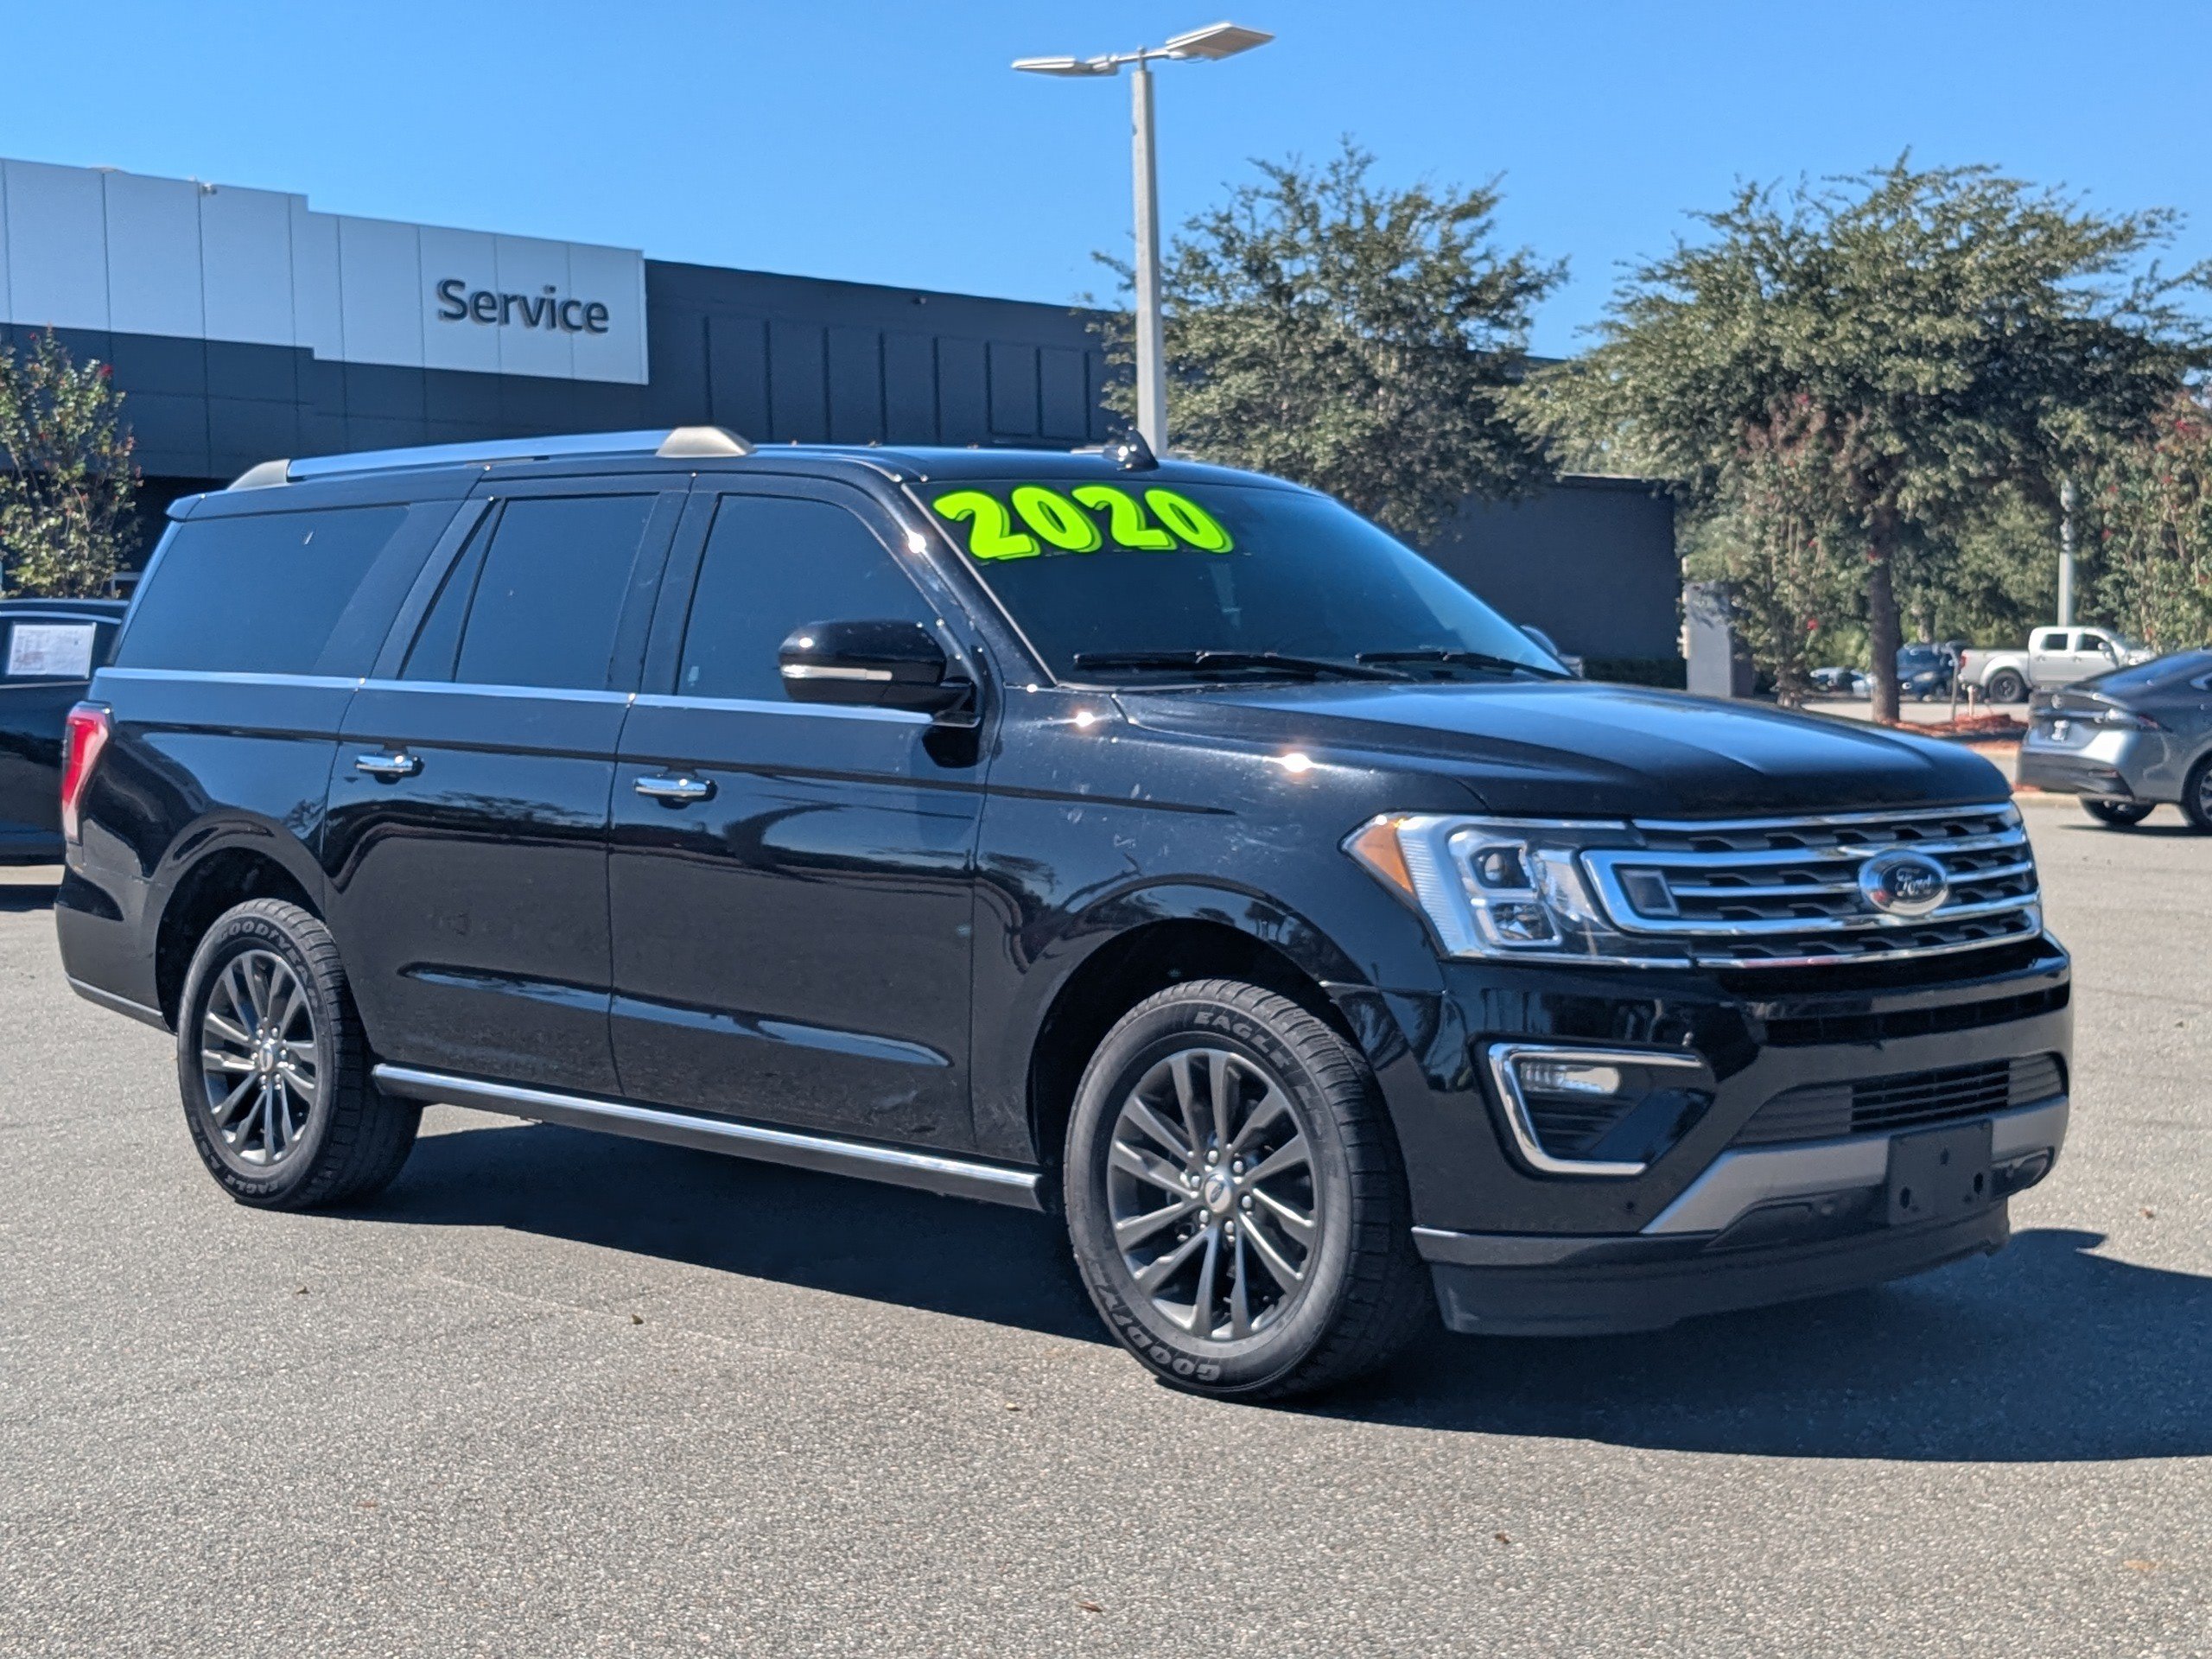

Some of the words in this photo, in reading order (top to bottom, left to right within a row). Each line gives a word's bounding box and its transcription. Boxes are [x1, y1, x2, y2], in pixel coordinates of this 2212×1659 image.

[436, 277, 610, 334] Service
[932, 486, 1234, 560] 2020
[1895, 867, 1932, 897] Ford
[1193, 1011, 1291, 1069] EAGLE
